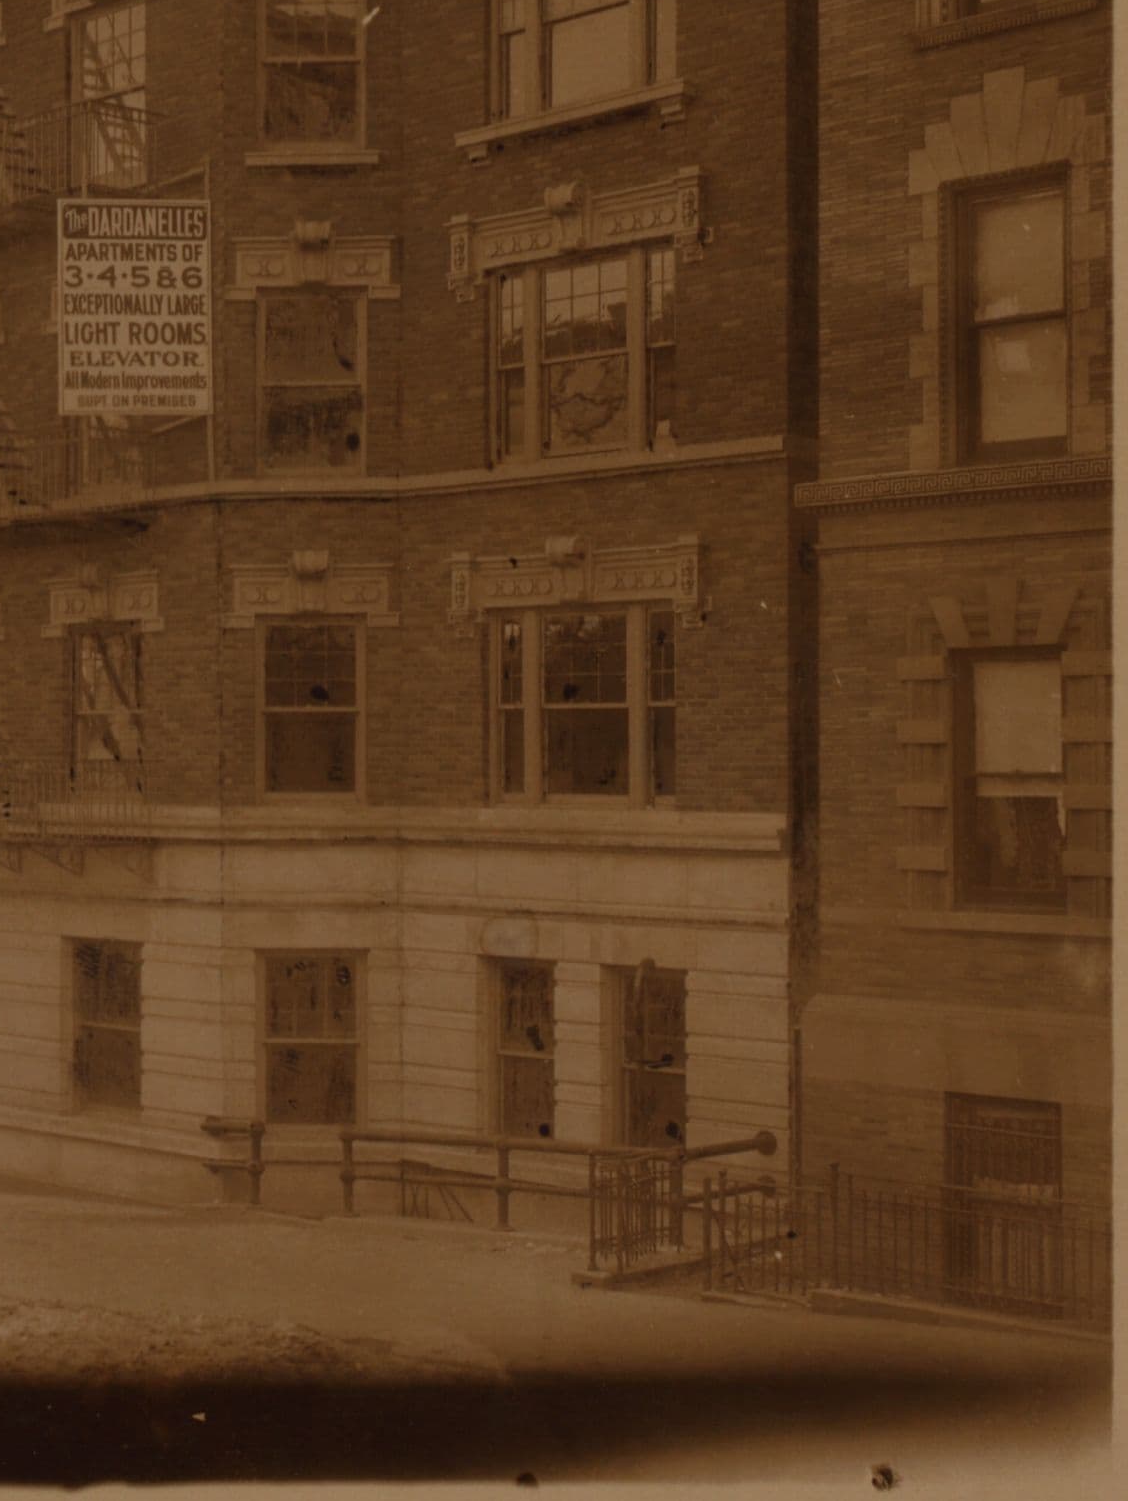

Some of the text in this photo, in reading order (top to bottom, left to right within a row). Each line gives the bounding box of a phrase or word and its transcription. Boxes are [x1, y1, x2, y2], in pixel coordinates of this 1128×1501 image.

[65, 207, 203, 236] The DARDANELLES
[66, 243, 202, 261] APARTMENTS OF
[64, 293, 205, 316] EXCEPTIONALLY LARGE
[65, 323, 206, 345] LIGHT ROOMS
[71, 351, 202, 367] ELEVATOR
[81, 375, 120, 388] Modern
[123, 372, 207, 390] Improvements
